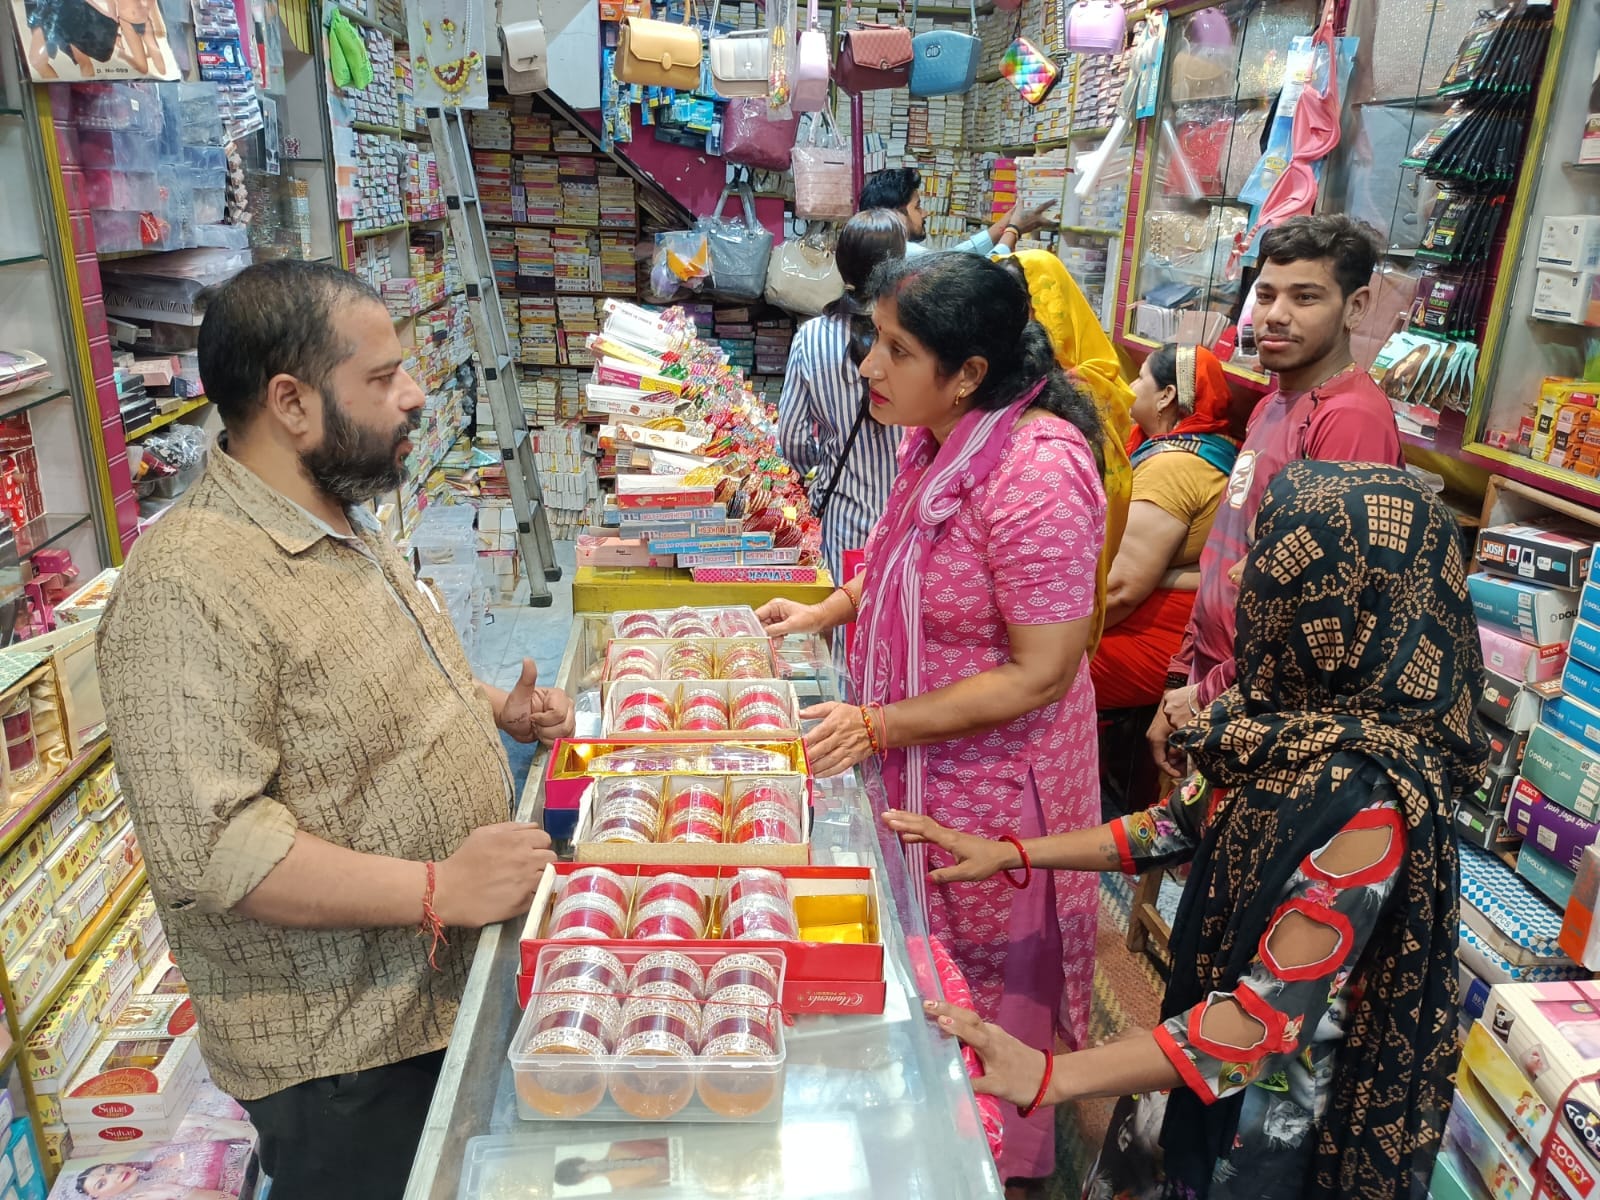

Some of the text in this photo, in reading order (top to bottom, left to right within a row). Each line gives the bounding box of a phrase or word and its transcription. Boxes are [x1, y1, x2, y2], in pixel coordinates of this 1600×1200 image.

[1484, 543, 1504, 556] JOSH
[748, 570, 780, 580] Vivek
[1533, 754, 1553, 769] DOLLAR
[1496, 913, 1512, 929] PCS
